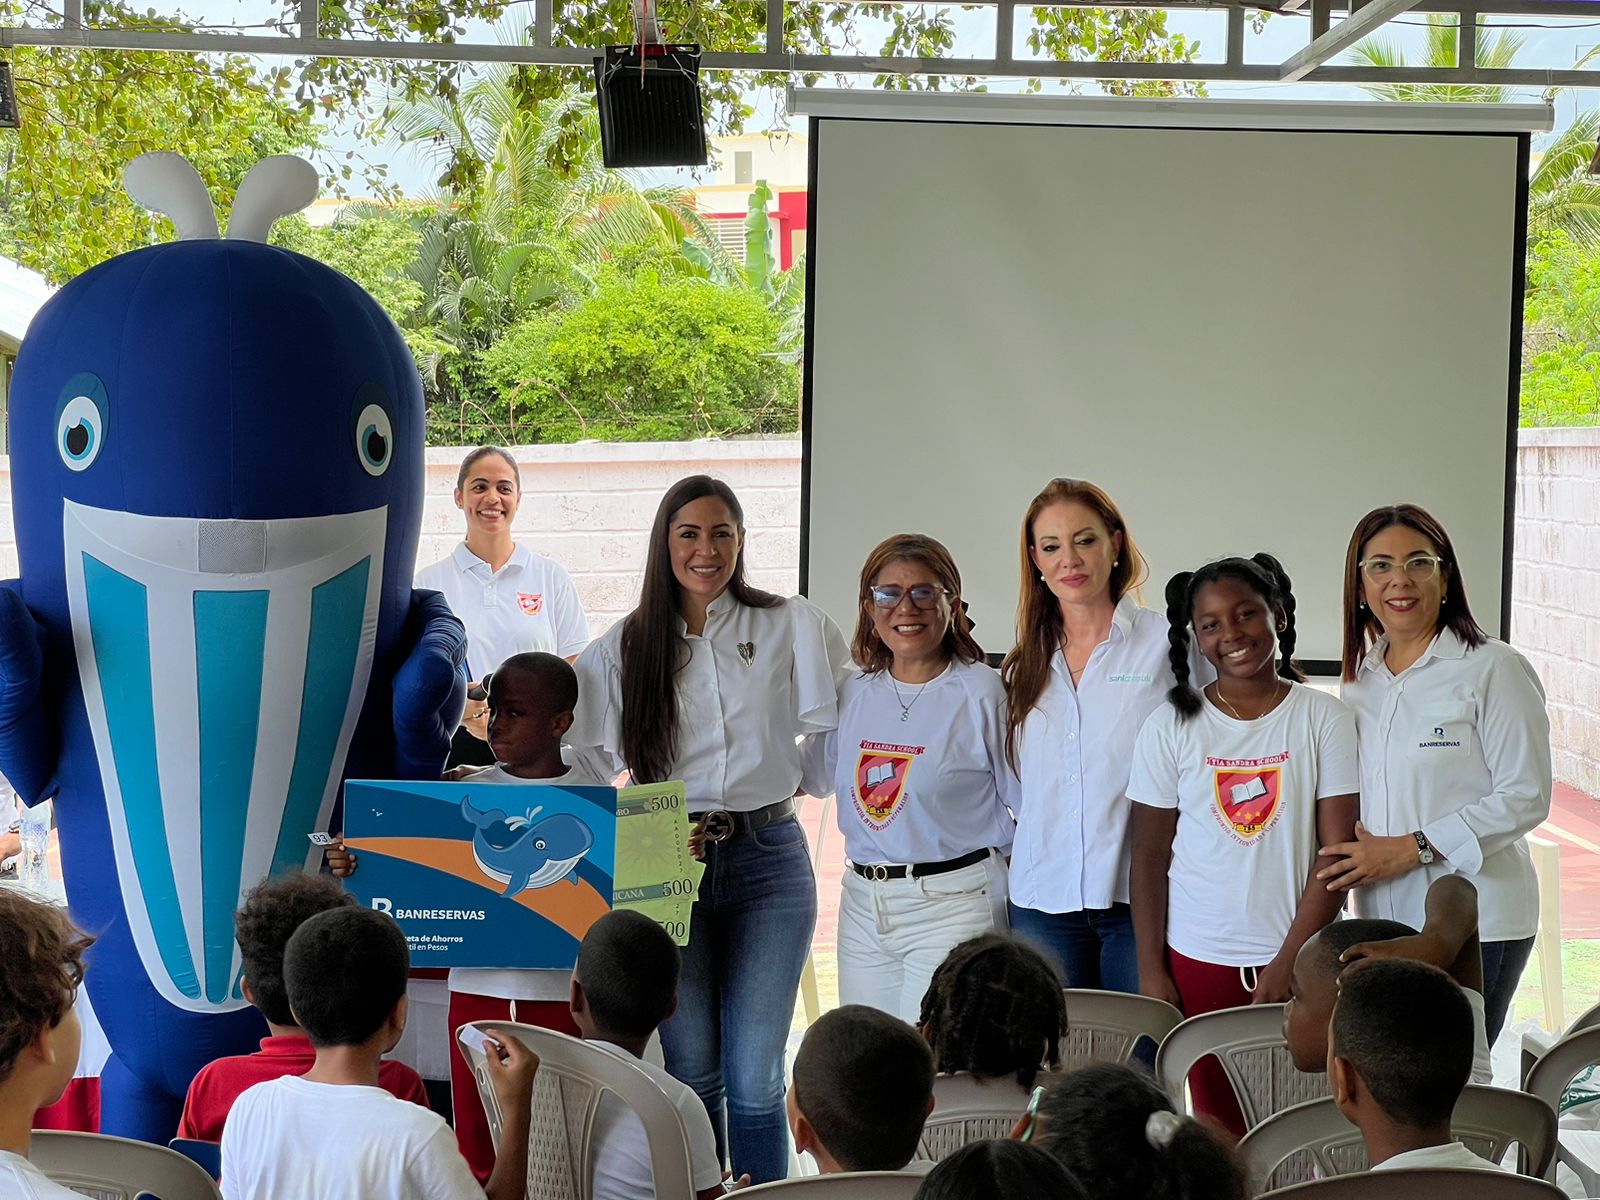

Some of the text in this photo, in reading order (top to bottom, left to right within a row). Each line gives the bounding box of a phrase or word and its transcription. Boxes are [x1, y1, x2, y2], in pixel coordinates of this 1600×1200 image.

[862, 741, 919, 754] TIA SANDRA SCHOOL
[1211, 758, 1225, 766] TIA
[1256, 756, 1284, 766] SCHOOL
[651, 794, 679, 811] 500
[313, 834, 328, 843] 93
[662, 878, 693, 897] 500
[613, 889, 645, 901] ICANA
[395, 909, 486, 921] BANRESERVAS
[656, 921, 686, 938] 00
[404, 935, 464, 943] eta de Ahorros
[427, 943, 449, 951] Pesos
